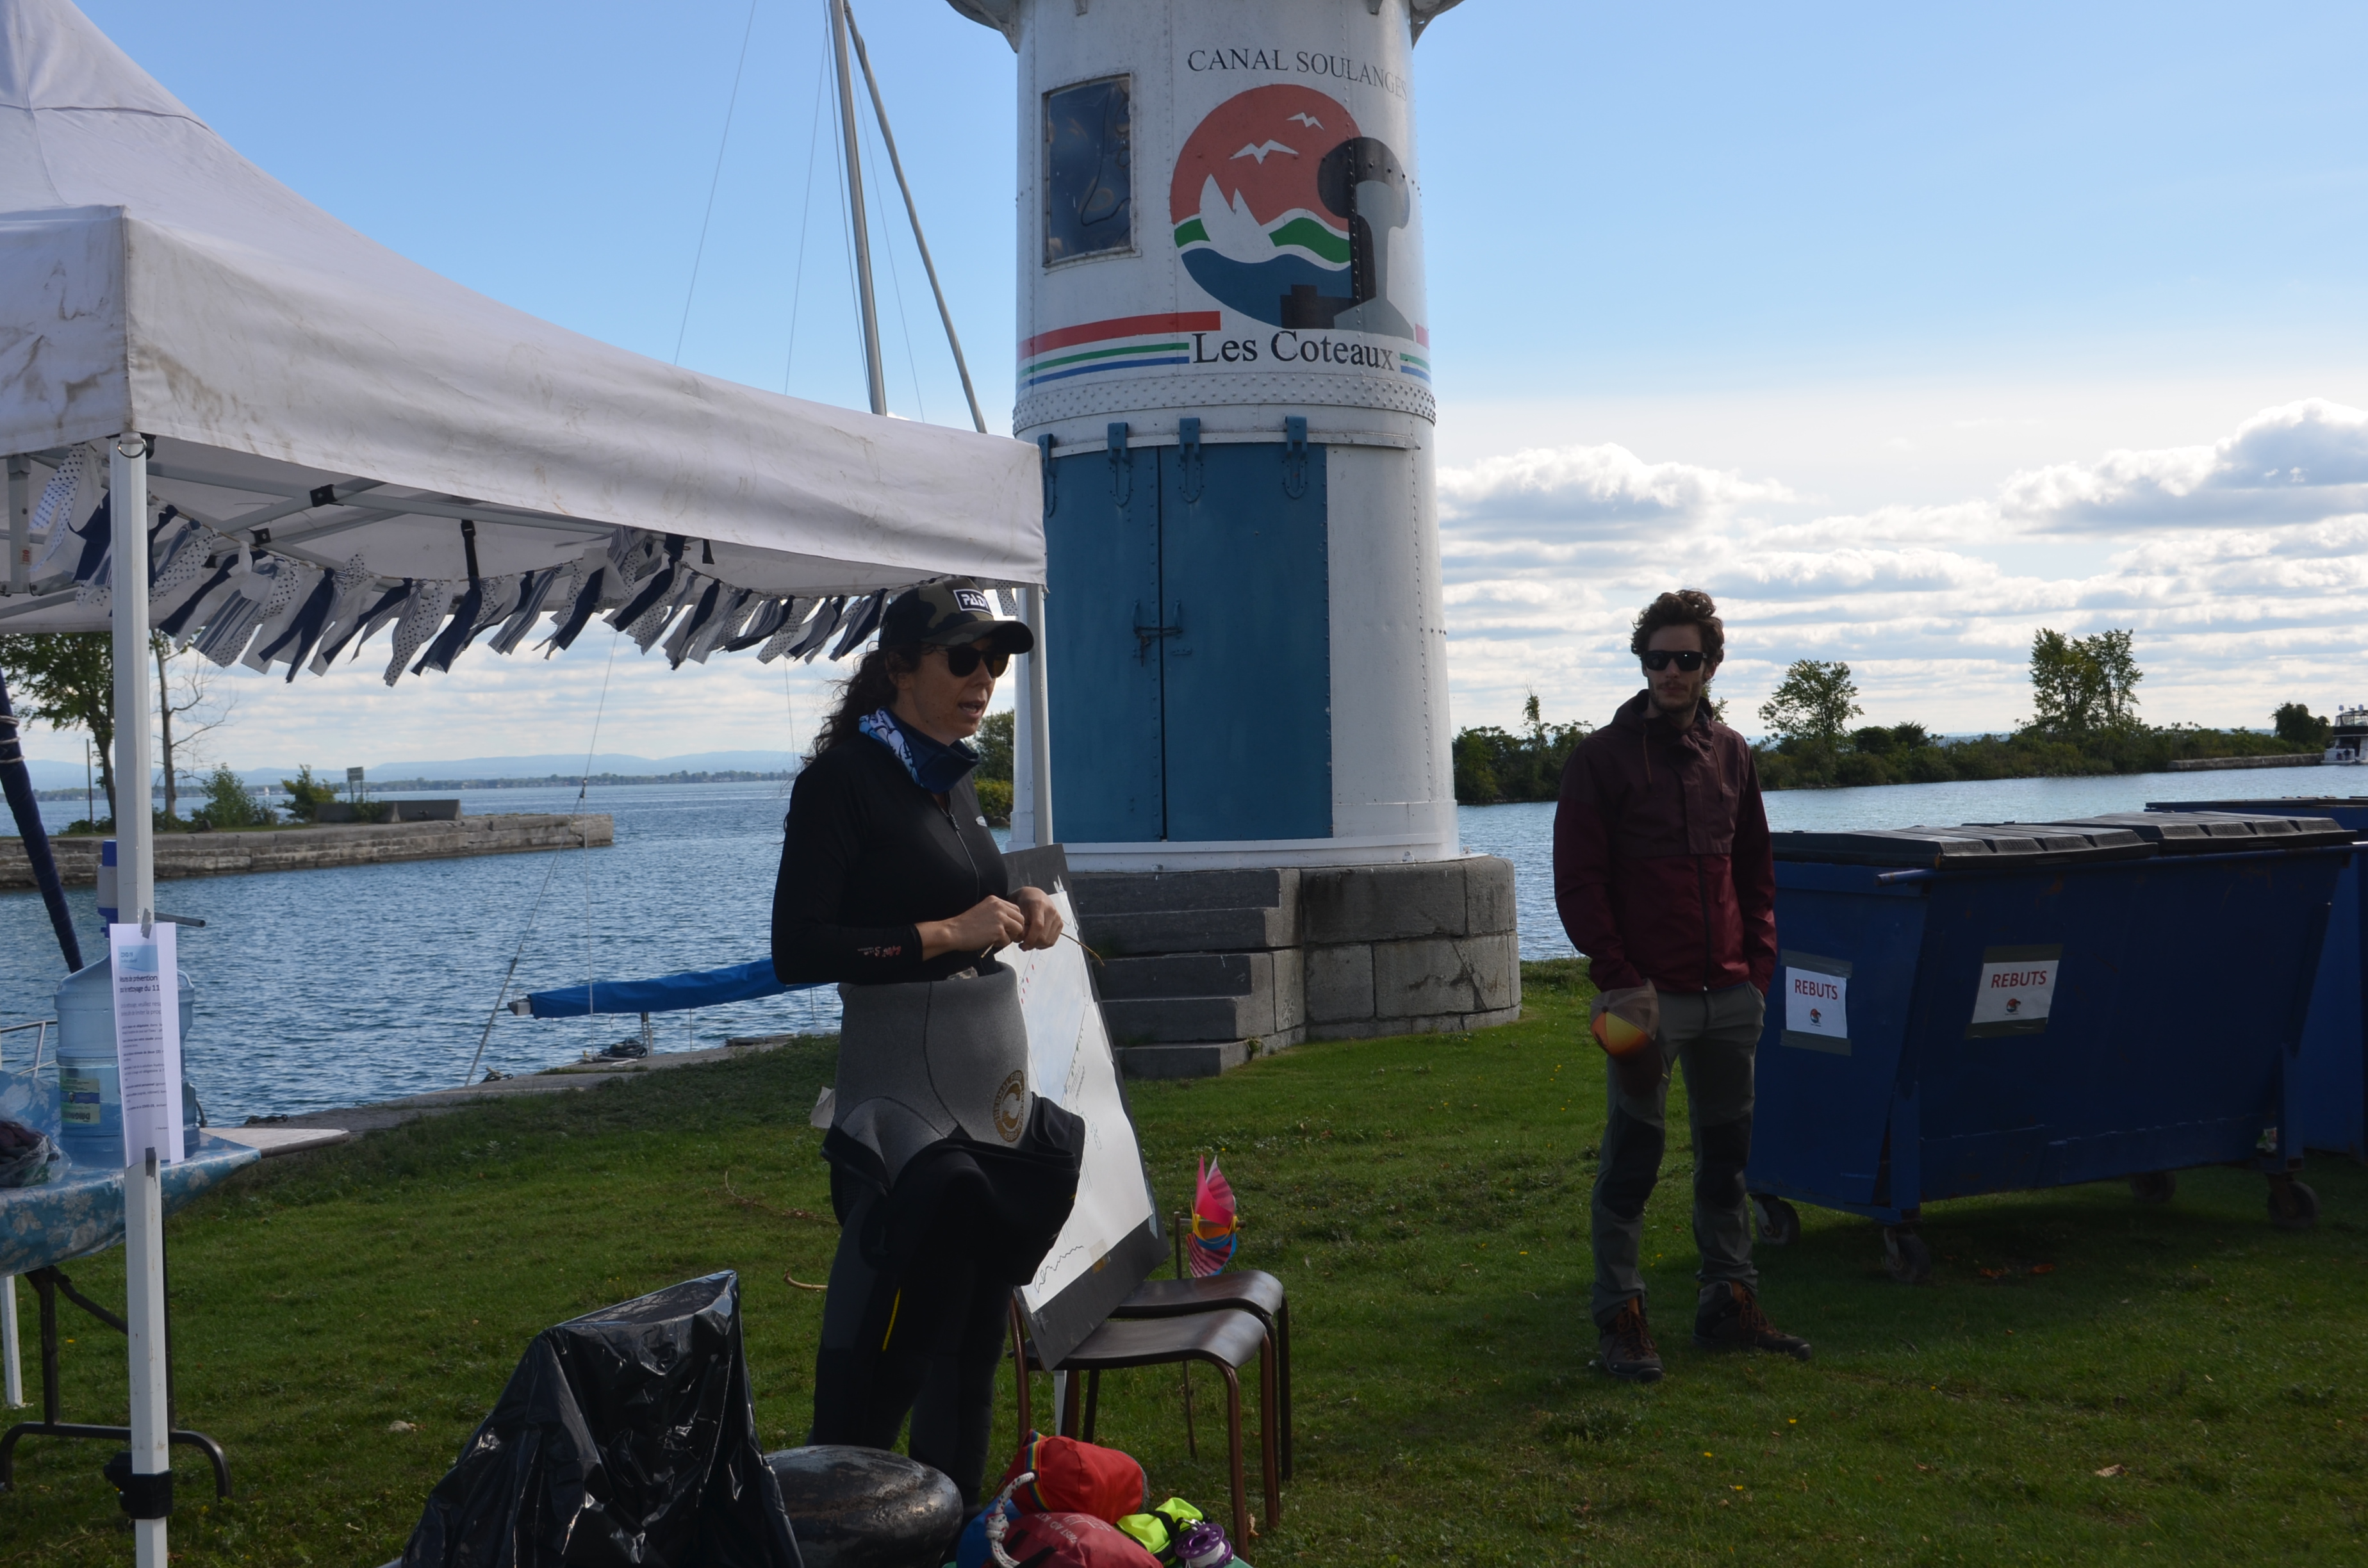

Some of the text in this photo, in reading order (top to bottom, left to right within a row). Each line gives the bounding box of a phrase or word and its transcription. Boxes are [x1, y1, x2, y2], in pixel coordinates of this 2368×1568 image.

[1187, 48, 1408, 102] CANAL SOULANGES
[1192, 330, 1395, 372] Les Coteaux
[133, 974, 158, 983] prévention
[1991, 970, 2047, 988] REBUTS
[1795, 979, 1838, 1000] REBUTS
[1060, 1529, 1078, 1544] FIRST
